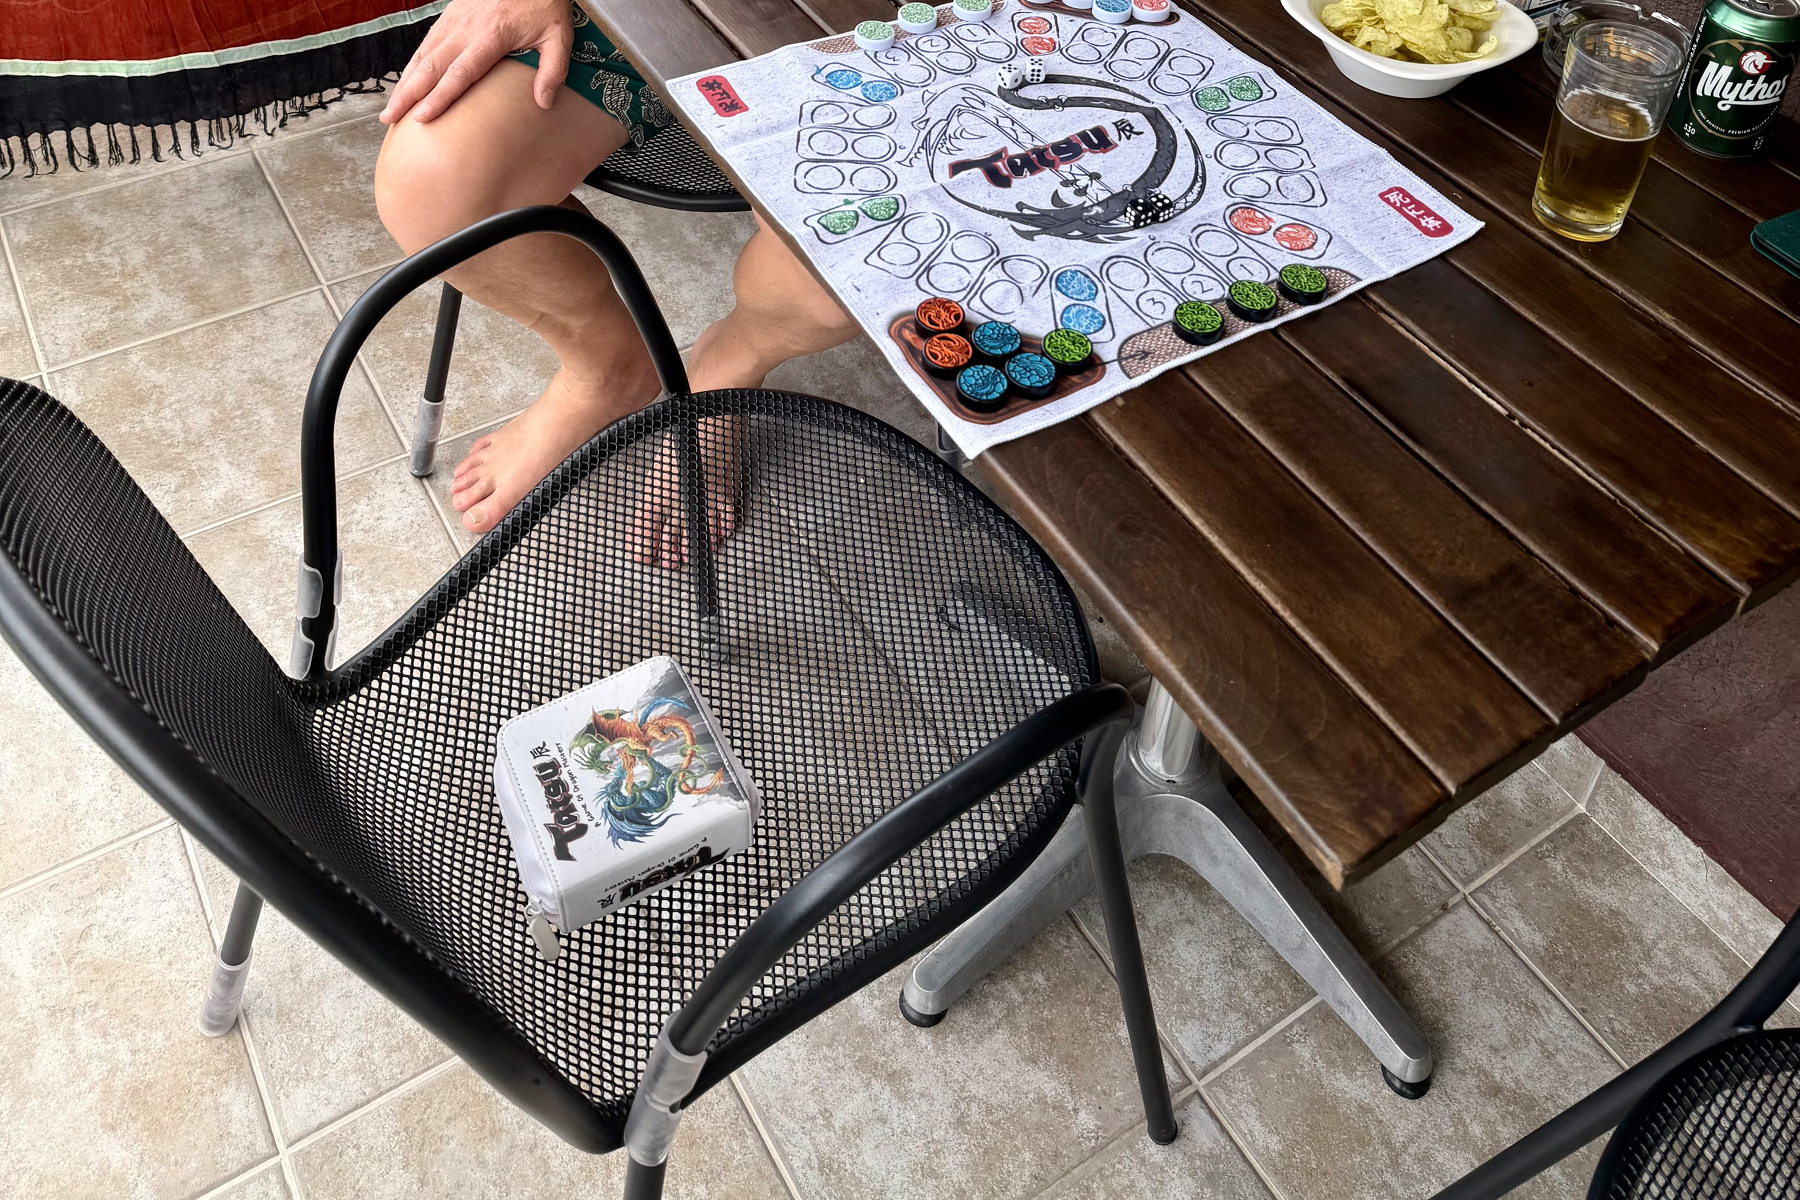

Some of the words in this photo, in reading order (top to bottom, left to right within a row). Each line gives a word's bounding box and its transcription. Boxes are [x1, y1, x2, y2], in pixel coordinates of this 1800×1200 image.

[922, 38, 940, 48] 2
[1696, 60, 1790, 112] Mythos
[1683, 122, 1696, 135] 330
[948, 124, 1119, 189] Tatsu
[1191, 280, 1214, 294] 2
[1146, 297, 1166, 315] 3
[566, 768, 581, 793] Dragon
[581, 802, 595, 822] Game
